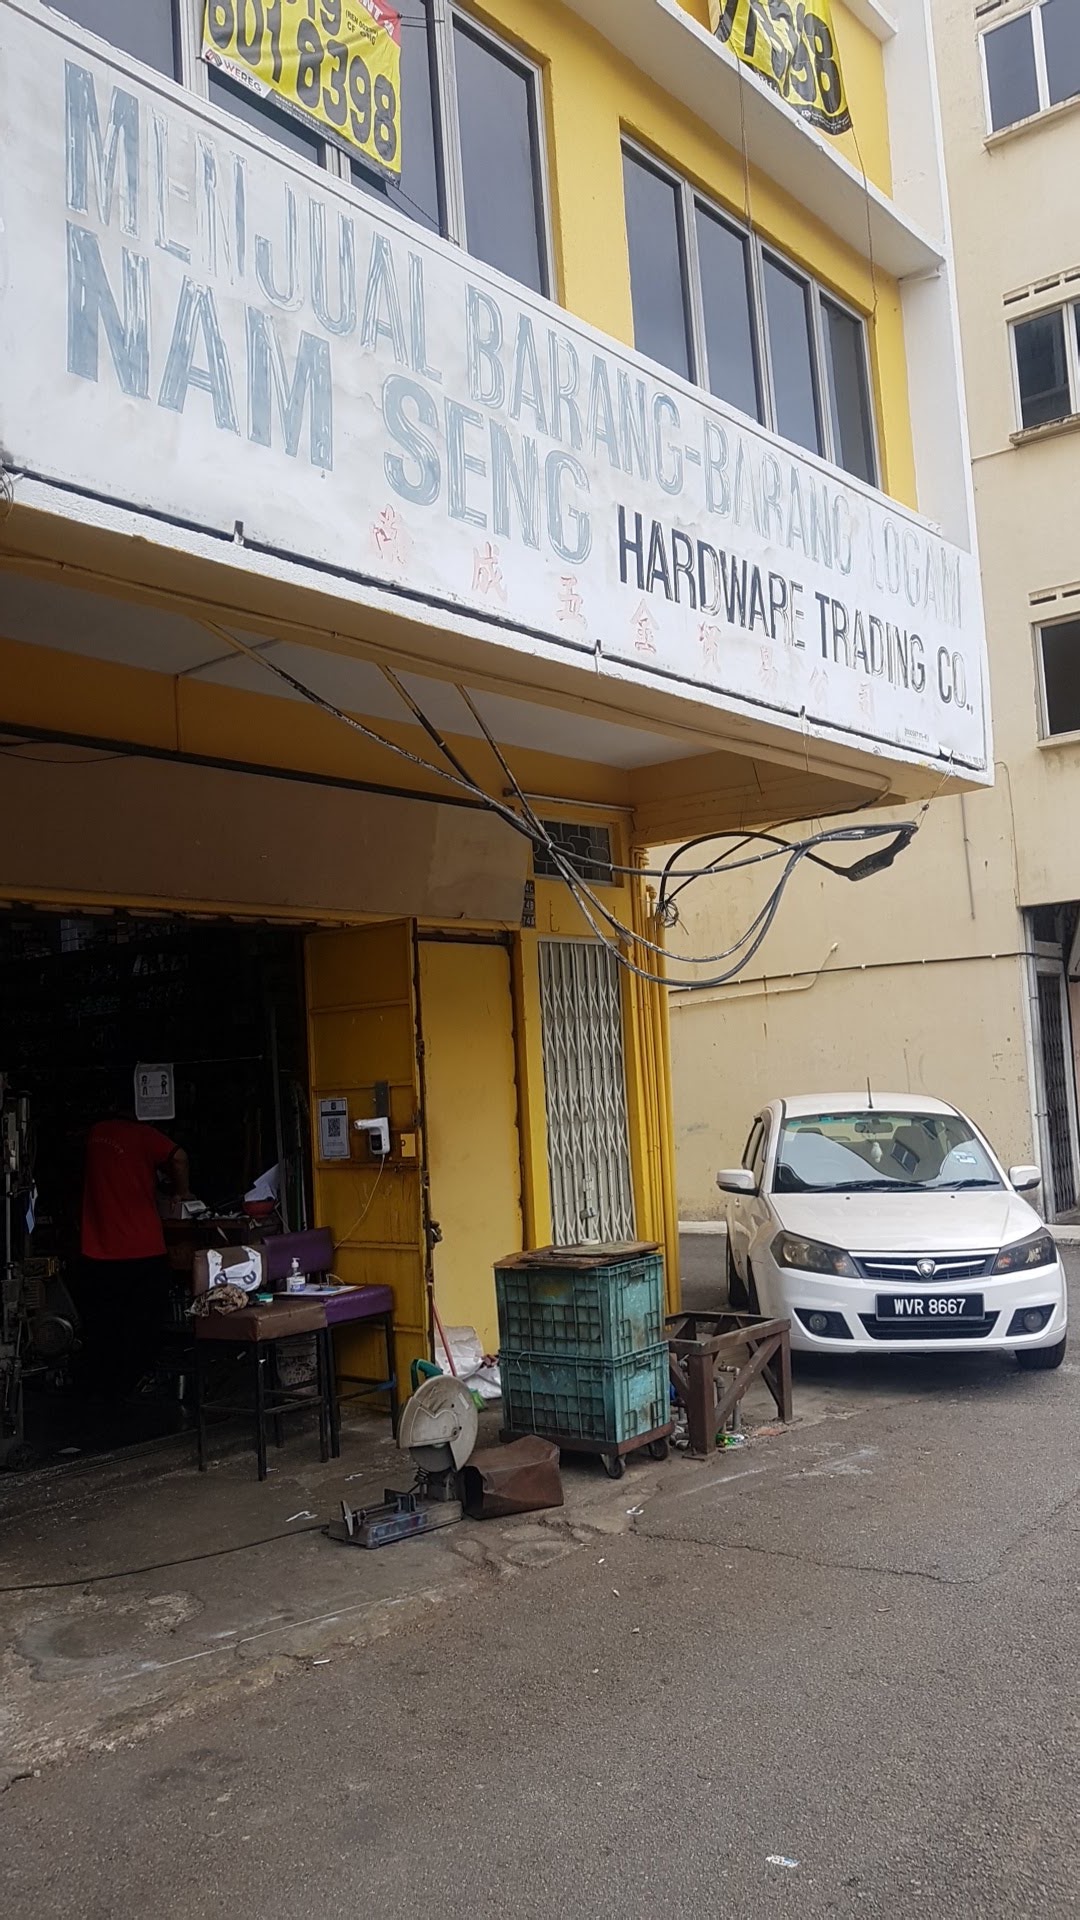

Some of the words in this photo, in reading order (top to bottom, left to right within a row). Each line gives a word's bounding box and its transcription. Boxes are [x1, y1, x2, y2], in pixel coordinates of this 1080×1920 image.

[297, 18, 397, 162] 8398
[64, 58, 443, 385] MENJUAL
[65, 218, 334, 472] NAM
[381, 372, 593, 565] SENG
[617, 503, 806, 650] HARDWARE
[814, 590, 926, 694] TRADING
[893, 1298, 925, 1315] WVR
[928, 1298, 967, 1315] 8667
